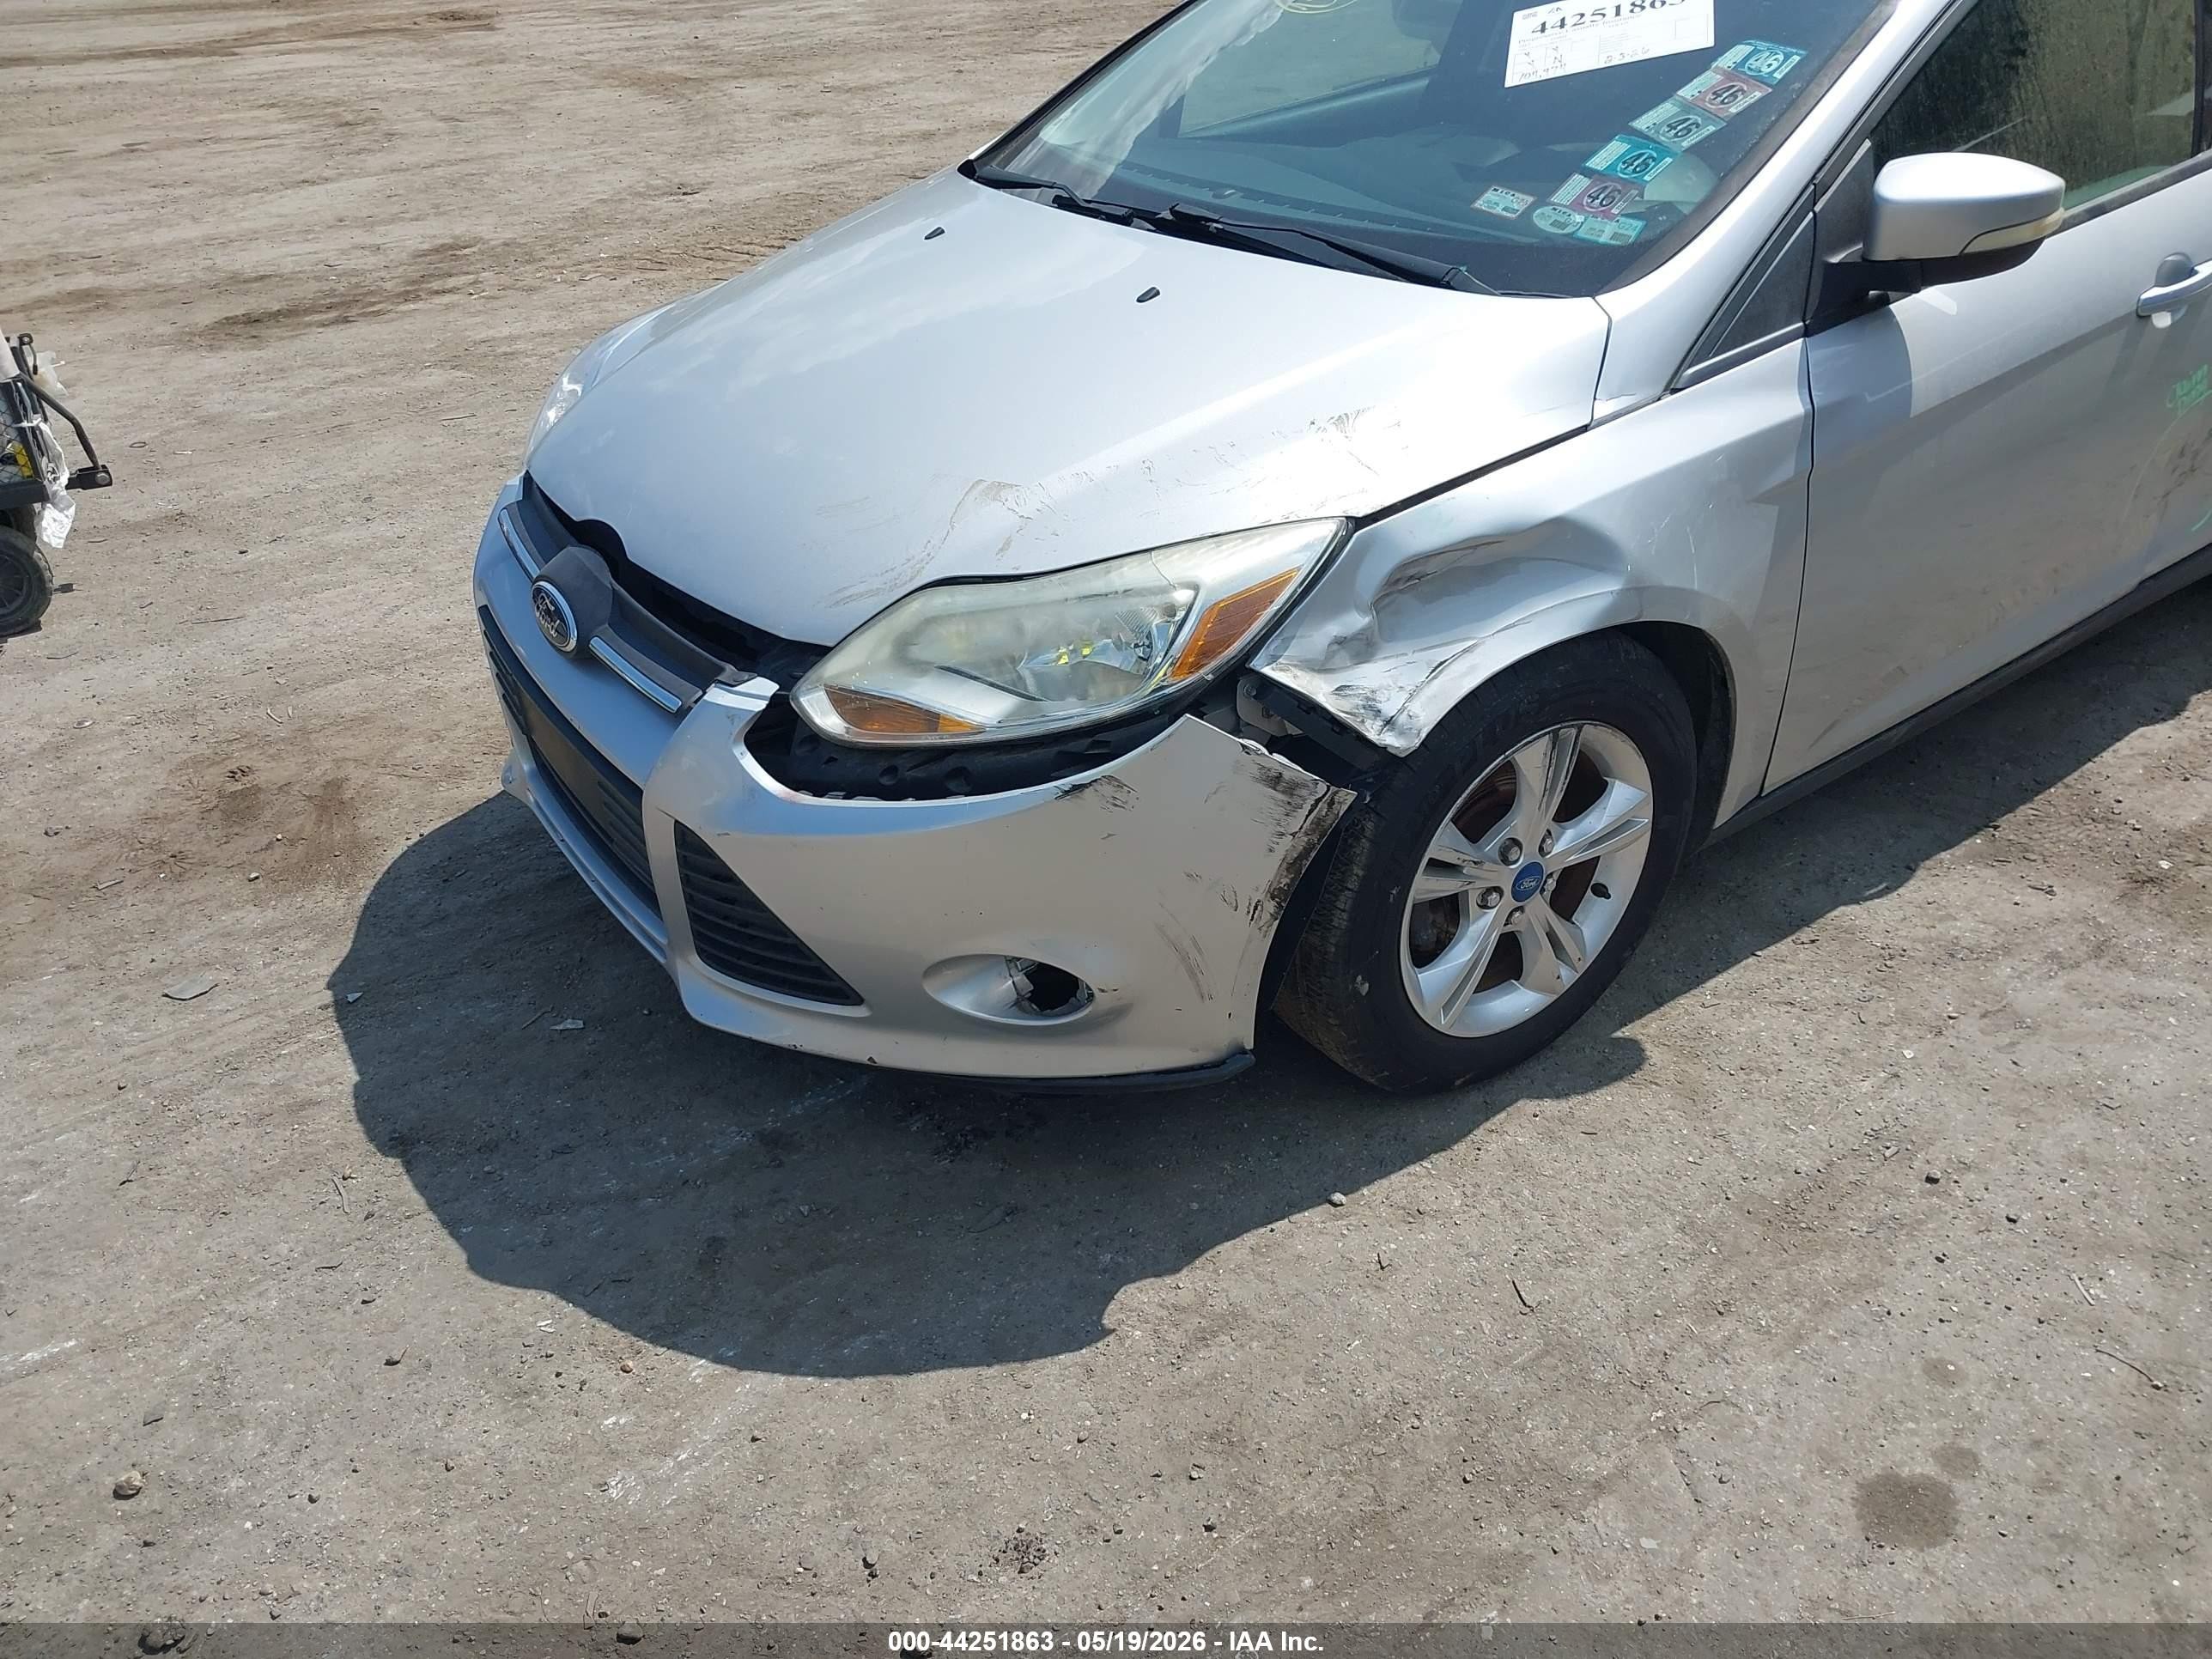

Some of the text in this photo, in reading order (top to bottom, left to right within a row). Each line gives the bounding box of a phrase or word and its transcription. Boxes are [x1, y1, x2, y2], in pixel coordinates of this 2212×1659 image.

[1710, 84, 1747, 106] 46
[1664, 117, 1701, 138] 46
[1620, 152, 1656, 173] 46
[1586, 185, 1622, 207] 46
[535, 593, 560, 637] Ford
